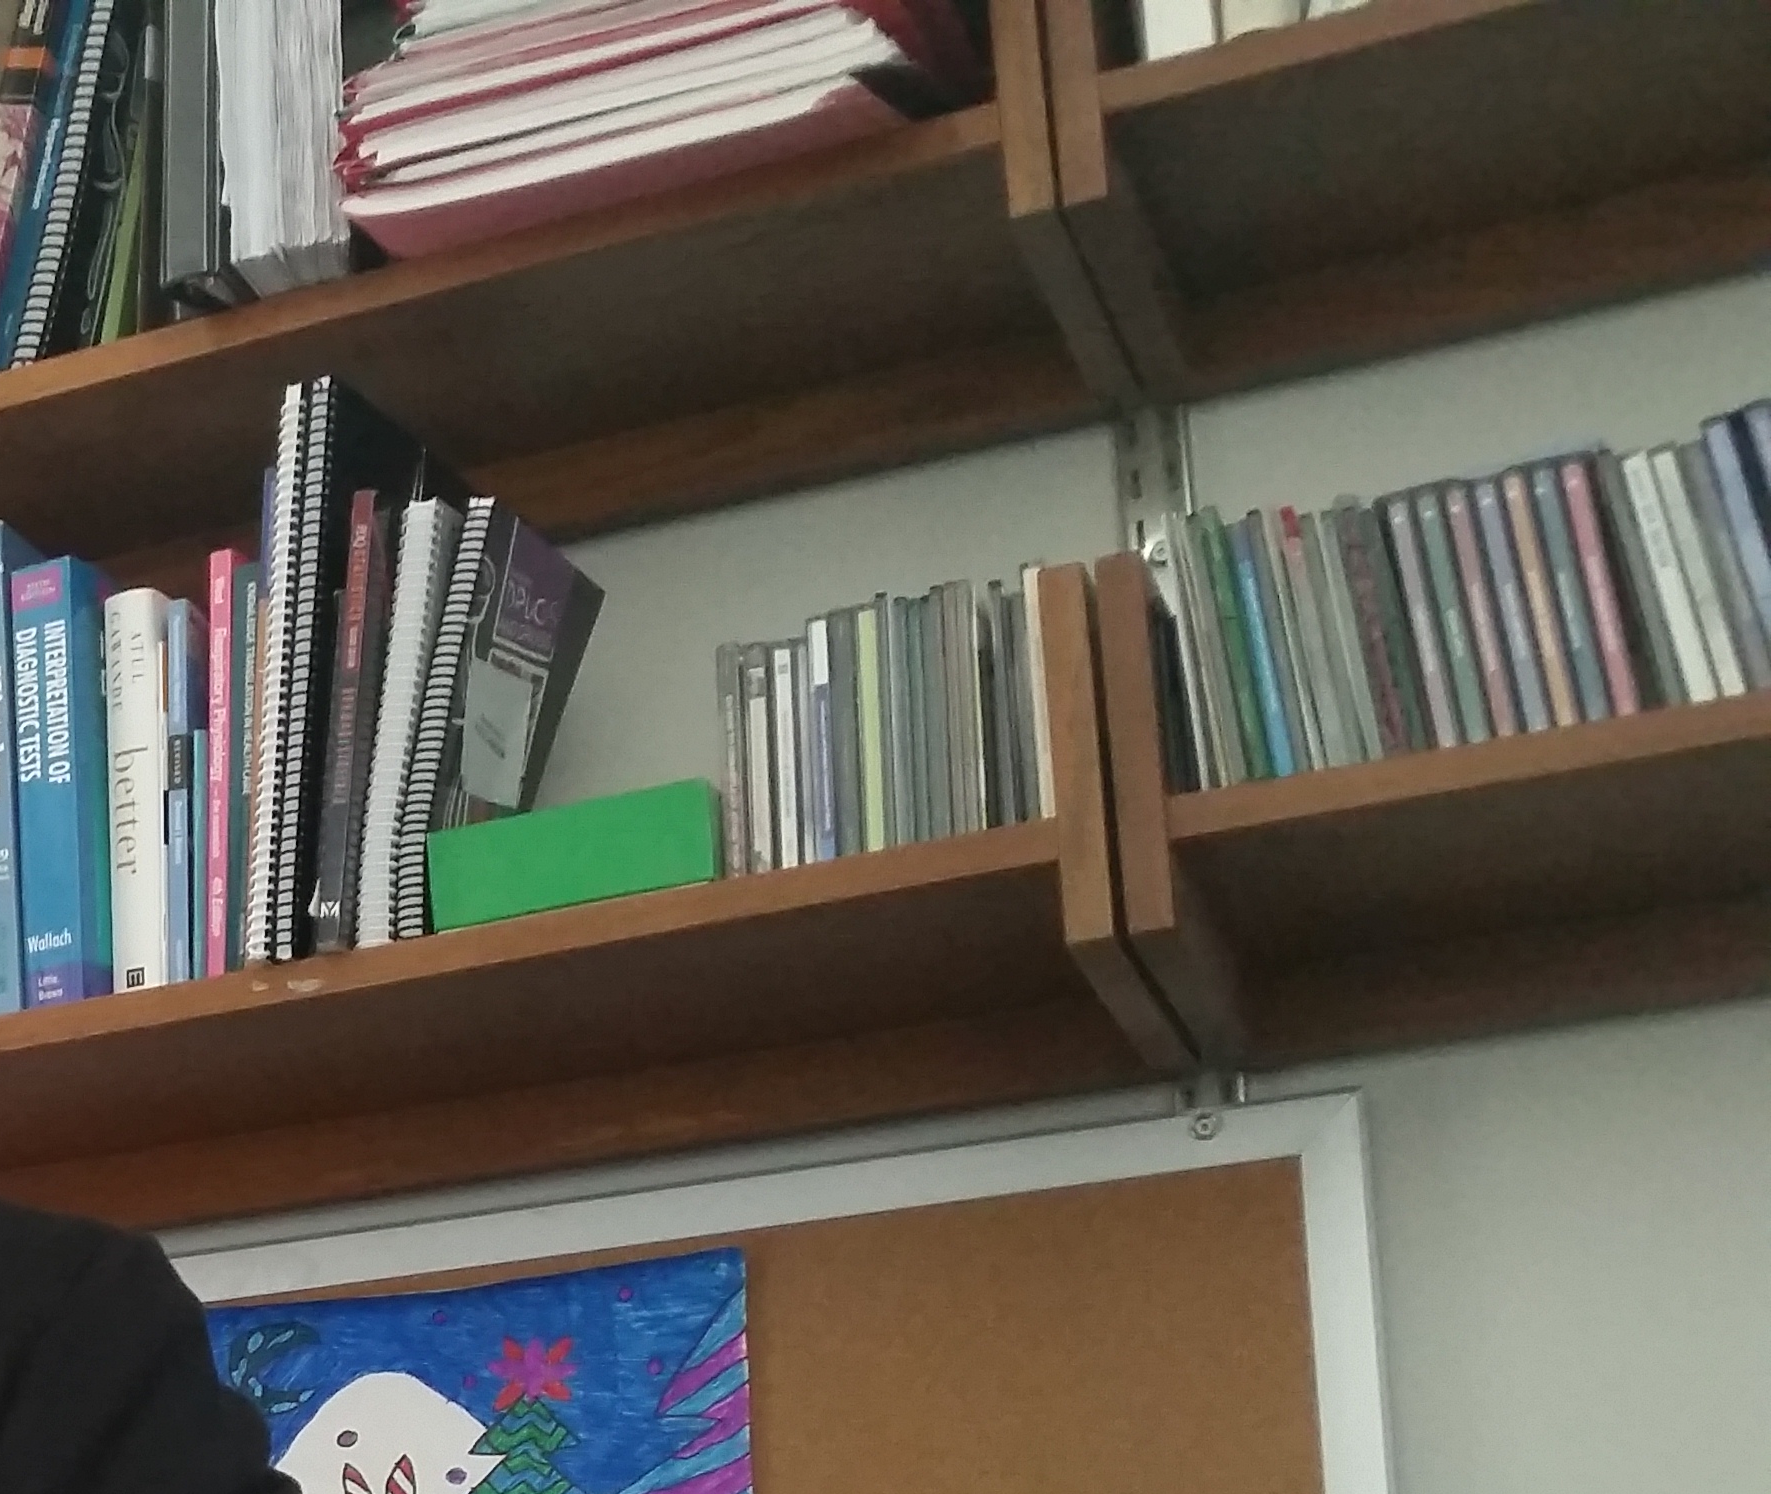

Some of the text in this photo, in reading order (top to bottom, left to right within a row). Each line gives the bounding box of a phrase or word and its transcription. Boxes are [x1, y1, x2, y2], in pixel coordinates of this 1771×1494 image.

[15, 626, 42, 784] DIAGNOSTIC TESTS
[43, 619, 71, 785] INTERPRETATION OF
[211, 627, 227, 708] Respiratory
[210, 708, 227, 782] Physiology
[114, 746, 149, 875] better
[27, 927, 72, 953] Wallach
